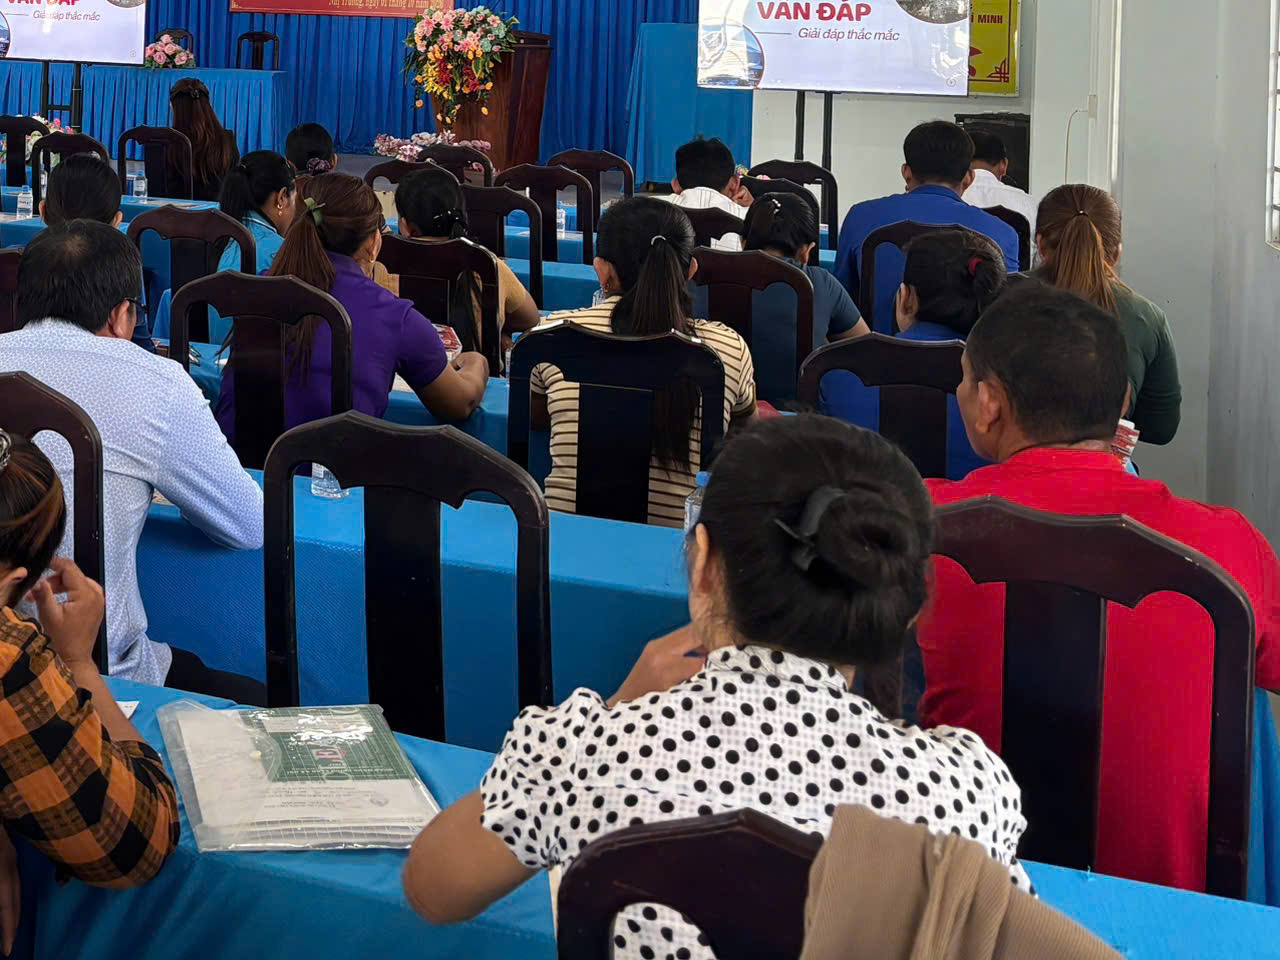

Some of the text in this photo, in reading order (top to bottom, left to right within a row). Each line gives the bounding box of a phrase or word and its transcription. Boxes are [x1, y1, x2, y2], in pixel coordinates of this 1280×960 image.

[66, 10, 82, 20] thắc
[83, 11, 100, 21] mắc
[978, 15, 1003, 24] MINH
[798, 27, 900, 42] Giải đáp thắc mắc
